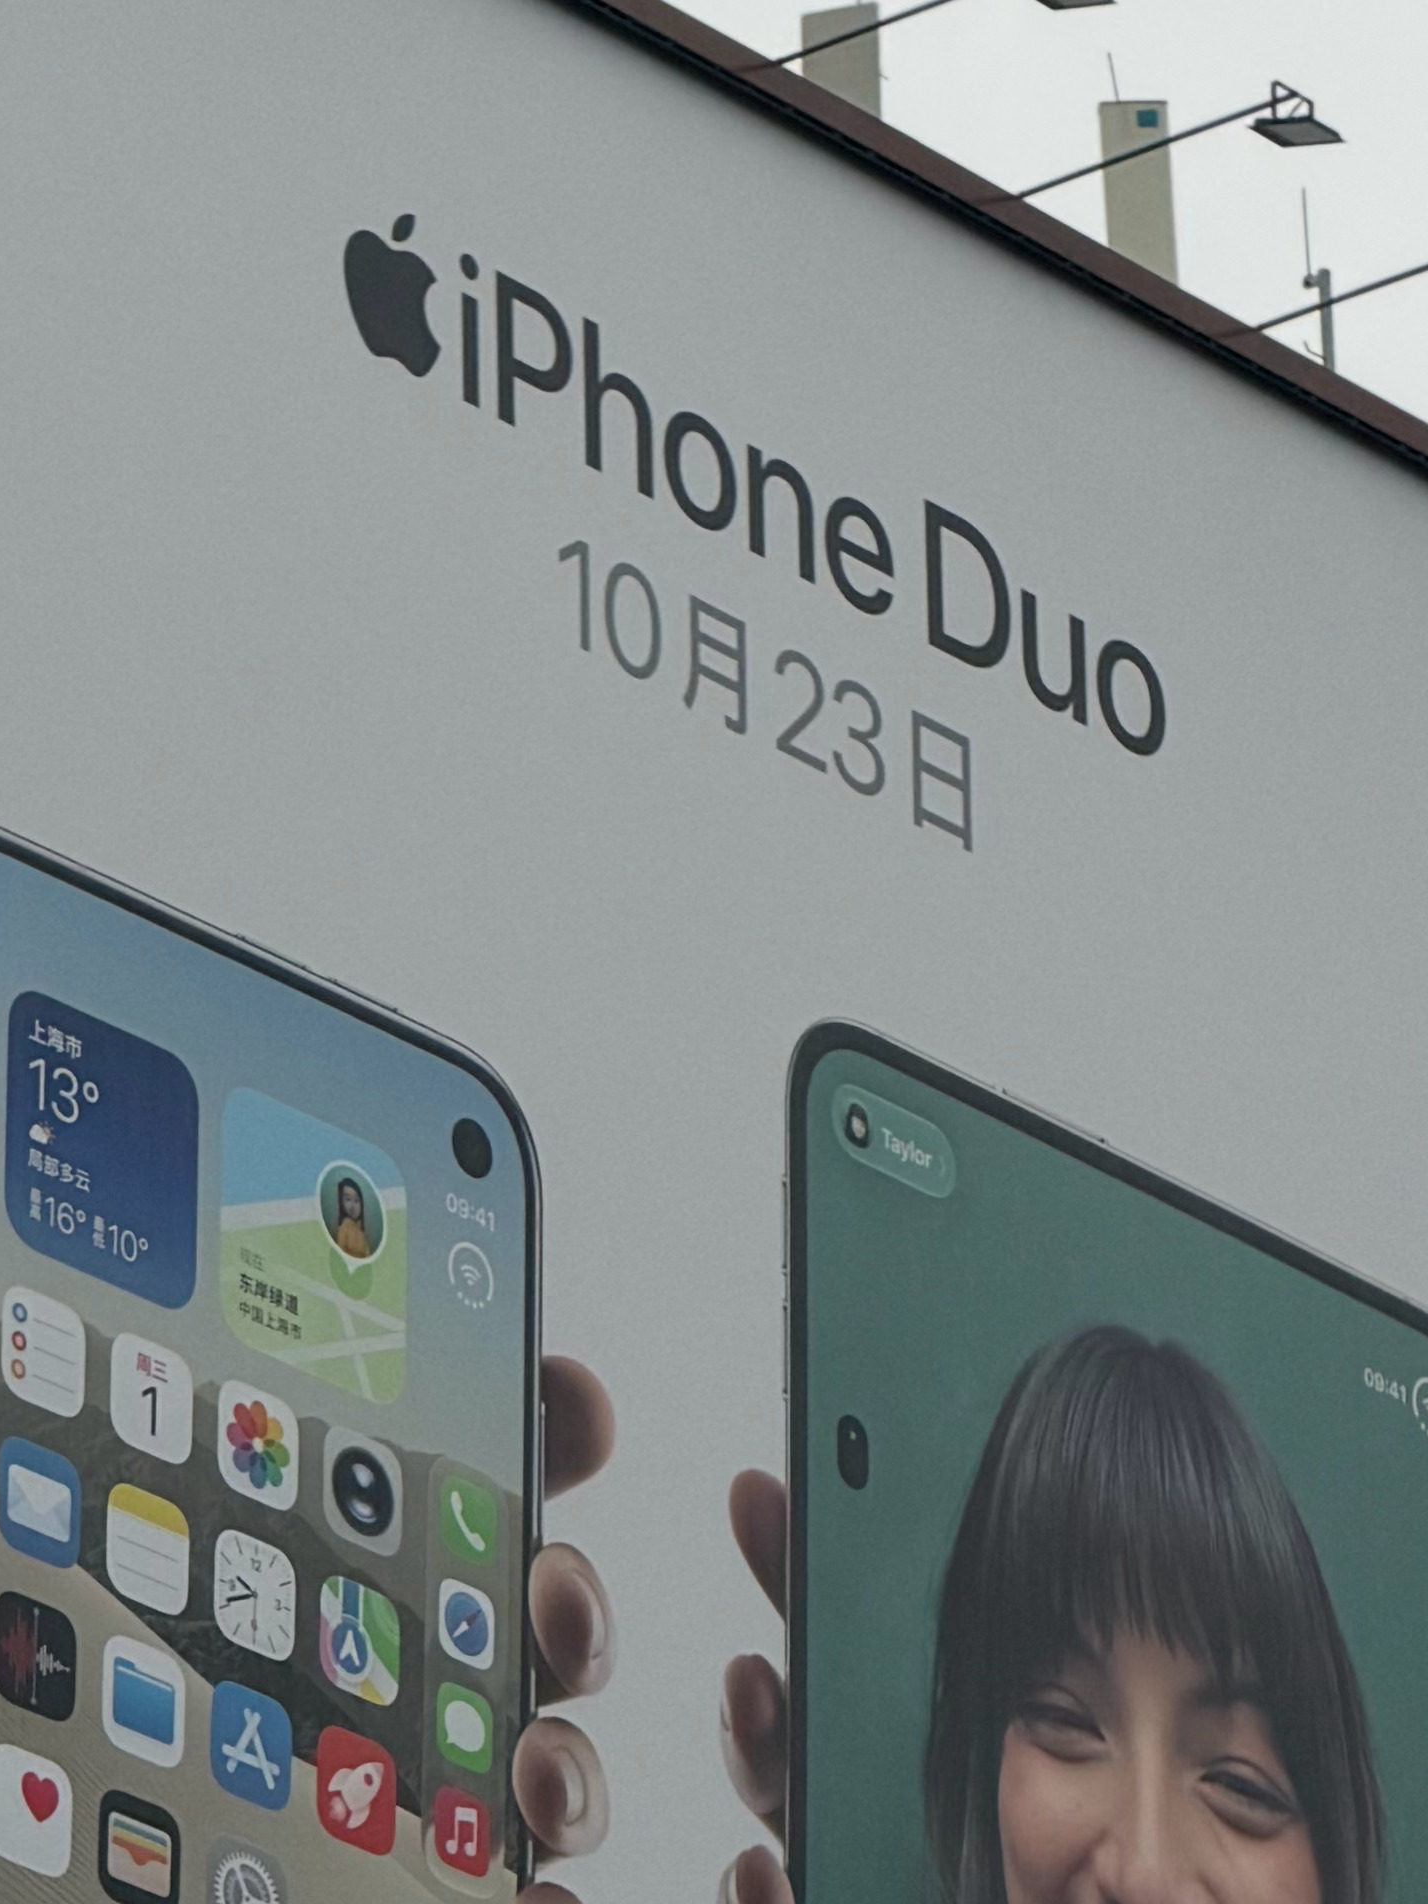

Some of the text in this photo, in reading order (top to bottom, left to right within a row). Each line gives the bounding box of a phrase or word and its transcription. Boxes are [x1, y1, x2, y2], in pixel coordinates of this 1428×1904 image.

[458, 252, 1167, 757] iPhone Duo
[557, 539, 974, 853] 10月23日
[28, 1018, 83, 1060] 上海市
[28, 1058, 99, 1124] 13°
[880, 1127, 933, 1169] Taylor
[45, 1196, 87, 1235] 16°
[107, 1224, 149, 1262] 10°
[446, 1192, 495, 1232] 09:41
[141, 1386, 157, 1436] 1
[1363, 1367, 1407, 1406] 09:41
